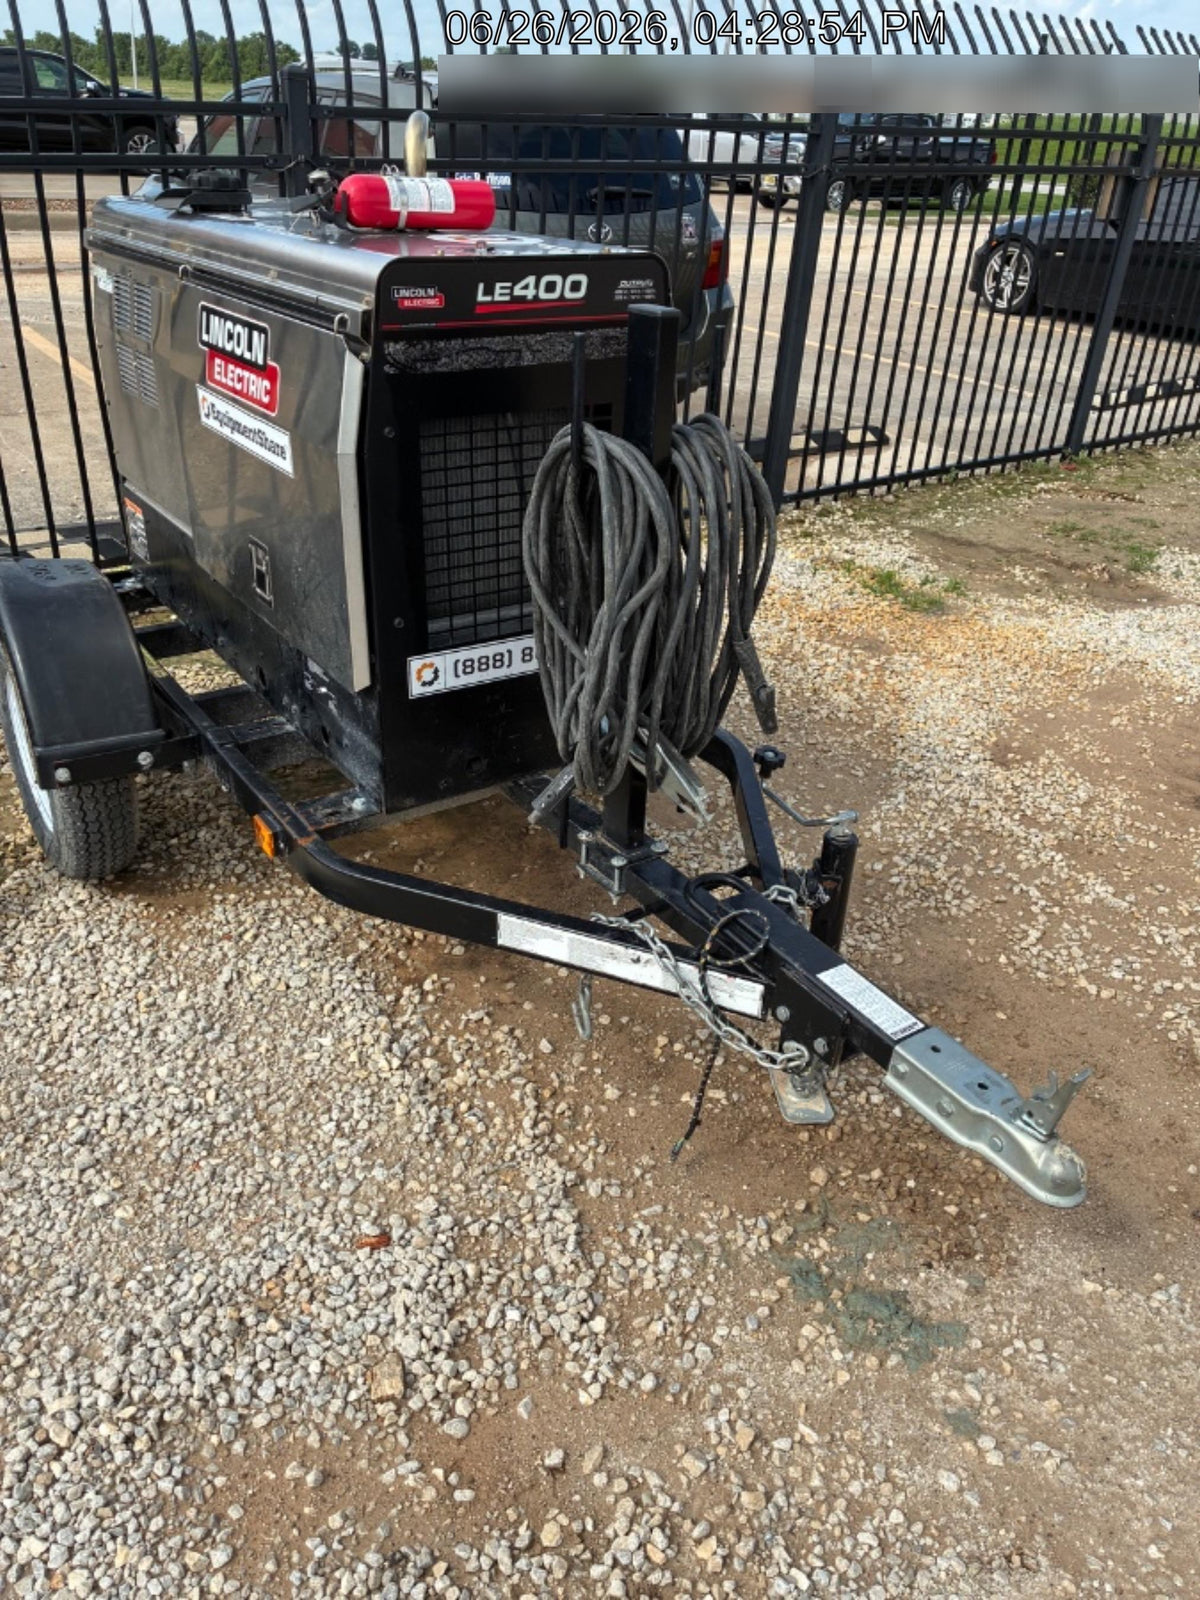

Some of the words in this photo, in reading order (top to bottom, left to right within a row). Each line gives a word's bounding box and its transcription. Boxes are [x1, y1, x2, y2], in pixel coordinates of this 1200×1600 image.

[394, 287, 435, 298] LINCOLN
[404, 298, 440, 307] ELECTRIC
[476, 274, 588, 301] LE400
[201, 310, 266, 366] LINCOLN
[213, 357, 272, 404] ELECTRIC
[211, 402, 287, 461] EquipmentShare
[454, 649, 513, 679] (888)
